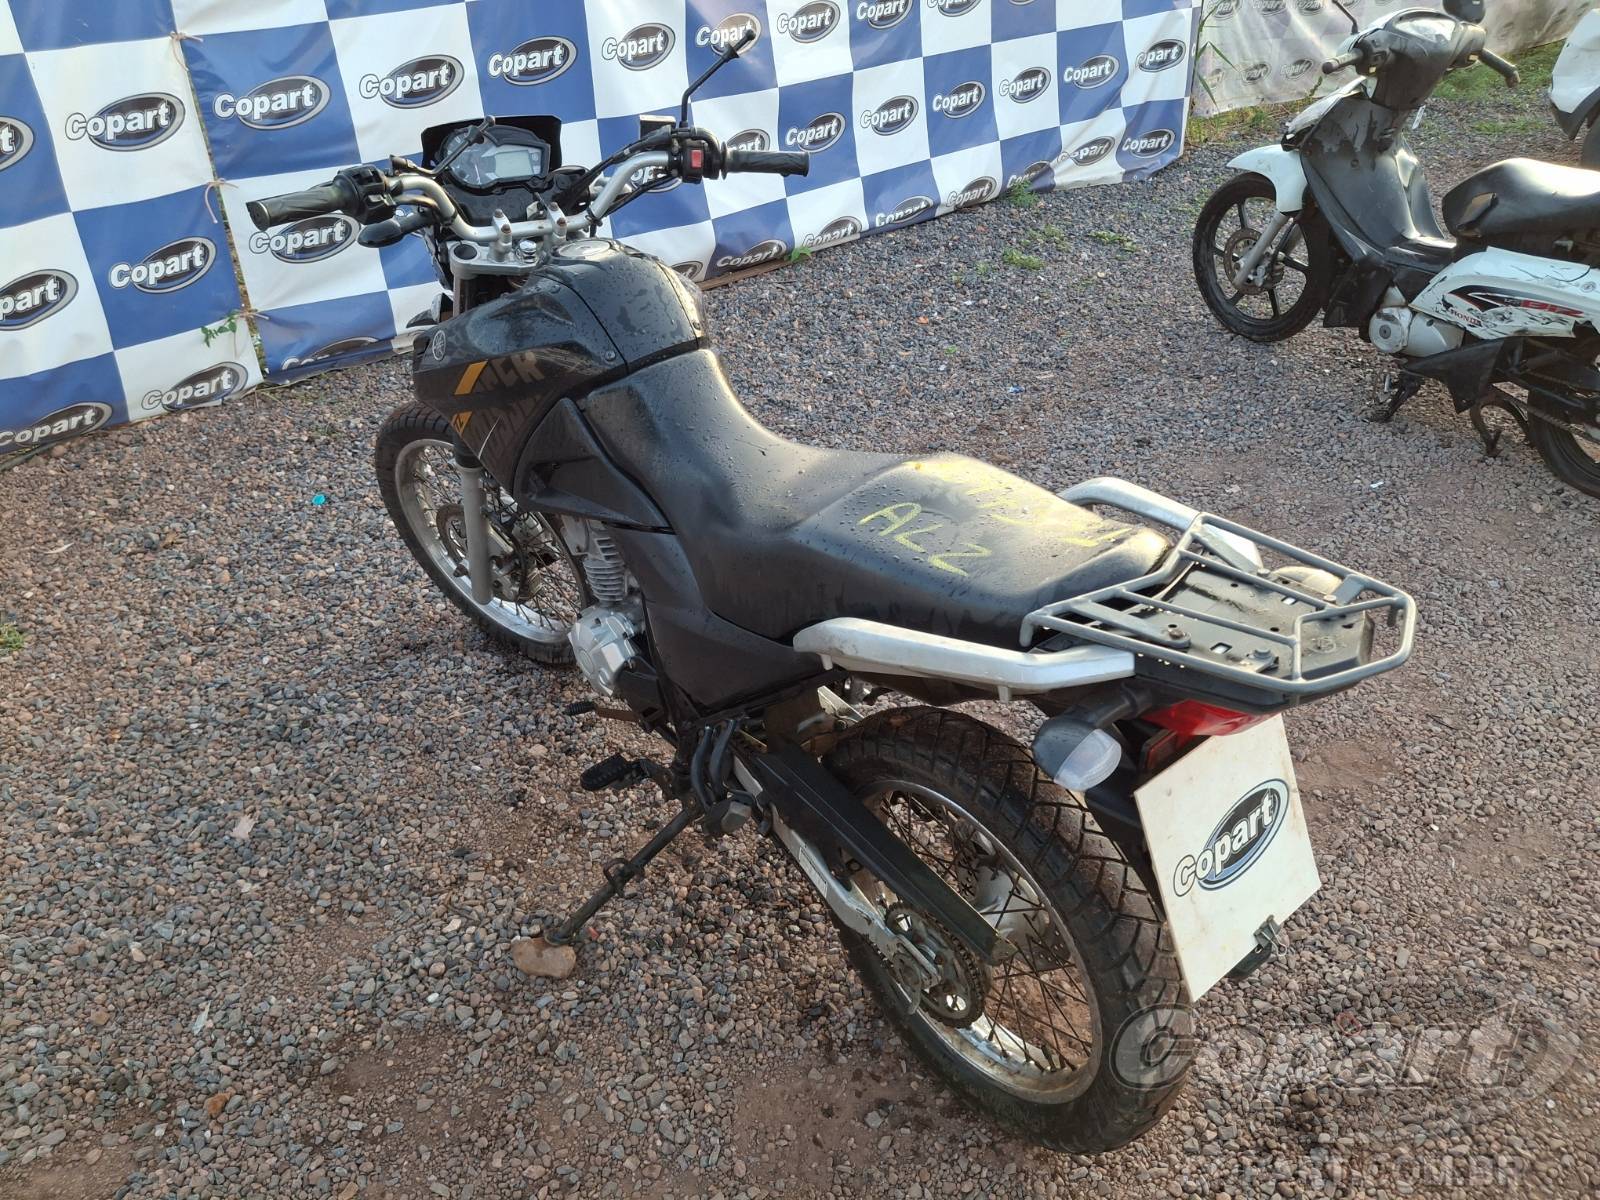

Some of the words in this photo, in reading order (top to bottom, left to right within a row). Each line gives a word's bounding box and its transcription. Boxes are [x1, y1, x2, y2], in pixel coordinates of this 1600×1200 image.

[778, 8, 831, 34] Copart
[857, 1, 904, 20] Copart
[602, 30, 664, 60] Copart
[488, 45, 564, 77] Copart
[1064, 61, 1111, 82] Copart
[360, 63, 449, 98] Copart
[1000, 73, 1044, 97] Copart
[214, 83, 316, 119] Copart
[933, 87, 979, 112] Copart
[65, 99, 171, 141] Copart
[861, 102, 912, 128] Copart
[786, 121, 837, 147] Copart
[1122, 133, 1169, 151] Copart
[946, 181, 990, 207] Copart
[249, 219, 346, 254] Copart
[110, 245, 205, 289] Copart
[717, 244, 779, 267] Copart
[0, 276, 60, 320] part
[142, 369, 232, 410] Copart
[0, 408, 96, 446] Copart
[1173, 790, 1275, 897] Copart
